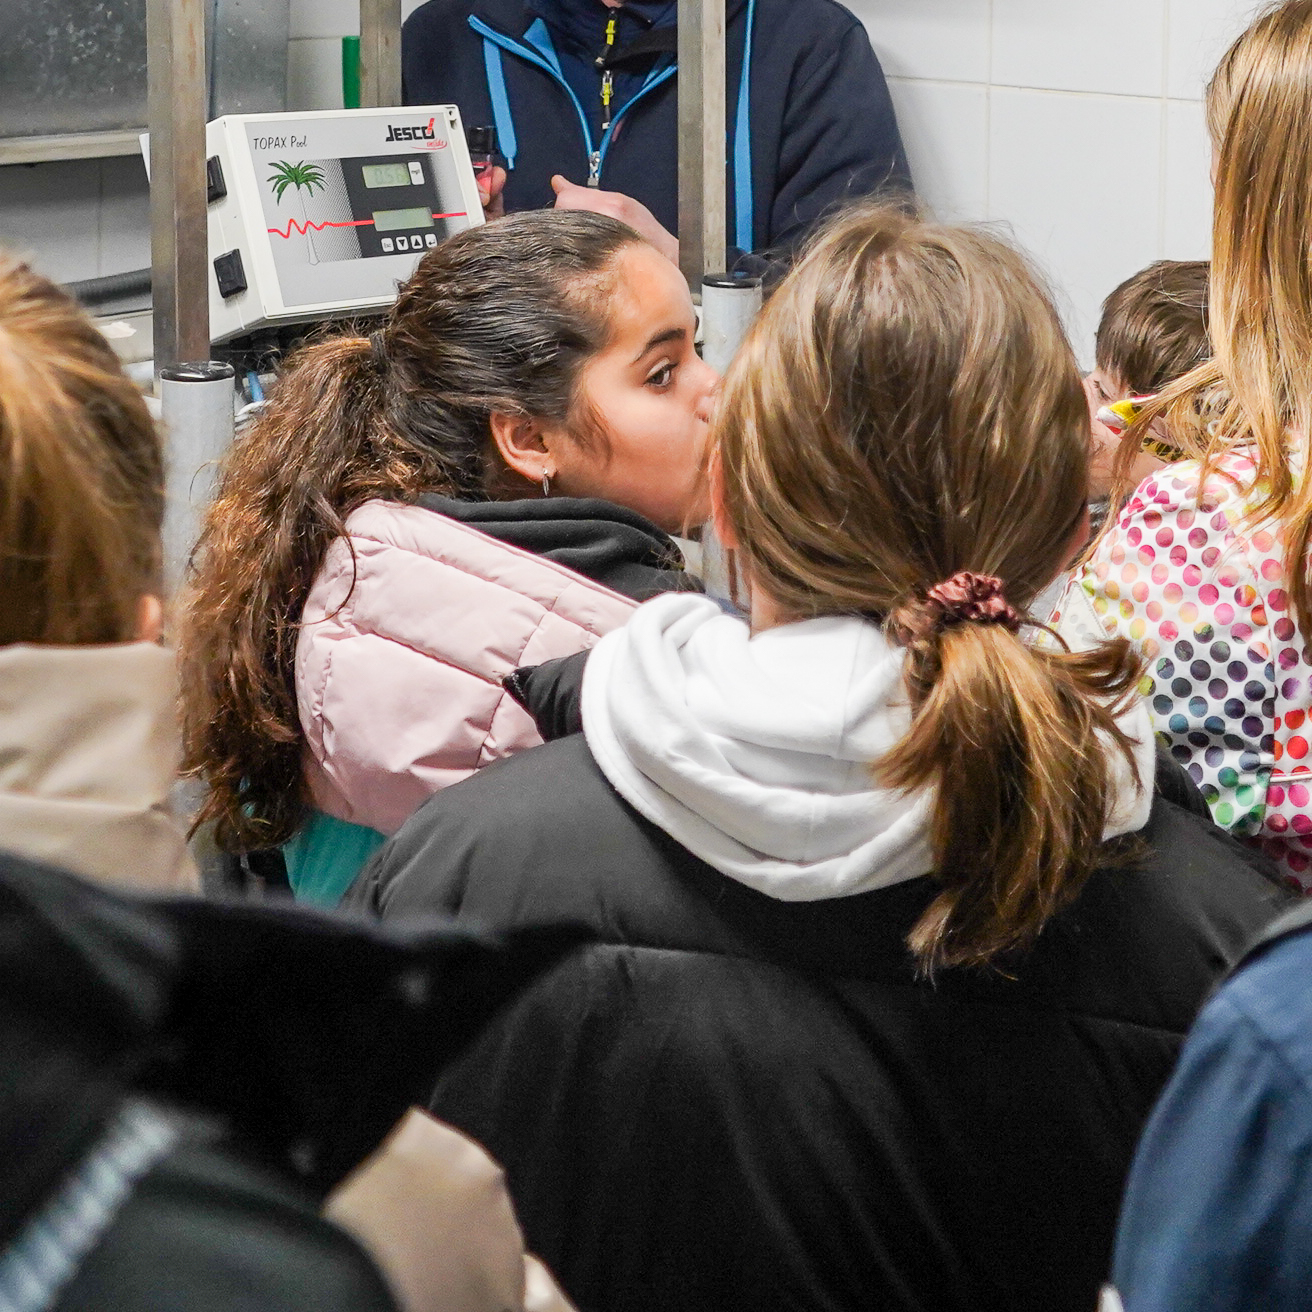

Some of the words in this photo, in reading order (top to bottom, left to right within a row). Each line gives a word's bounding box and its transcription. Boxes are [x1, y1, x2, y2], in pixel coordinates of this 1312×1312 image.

[385, 124, 436, 142] JESCO
[253, 136, 287, 150] TOPAX
[290, 135, 308, 148] Pool
